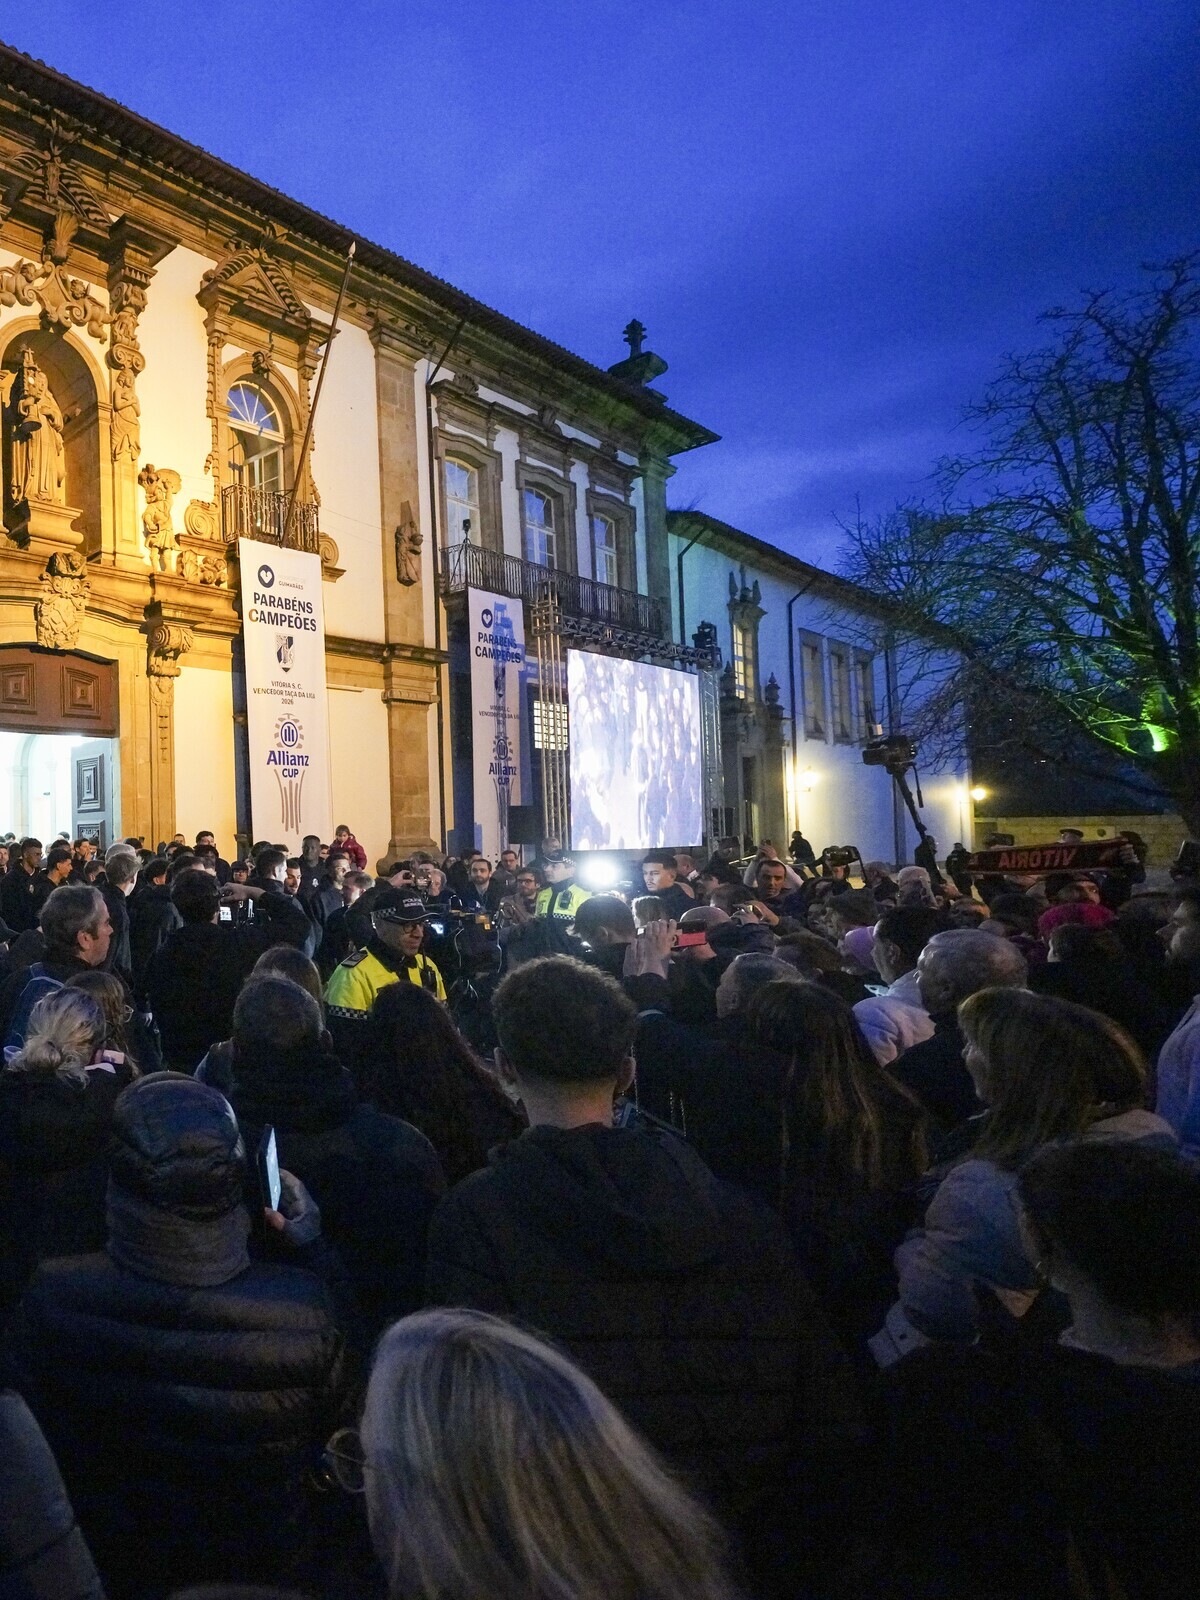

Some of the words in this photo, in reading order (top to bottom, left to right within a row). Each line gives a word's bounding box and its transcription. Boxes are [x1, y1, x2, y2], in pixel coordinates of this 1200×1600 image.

[254, 592, 313, 614] PARABÉNS
[248, 608, 317, 632] CAMPEÕES
[253, 688, 284, 696] VENCEDOR
[267, 751, 309, 767] Allianz
[282, 768, 299, 778] CUP
[489, 762, 517, 776] Allianz
